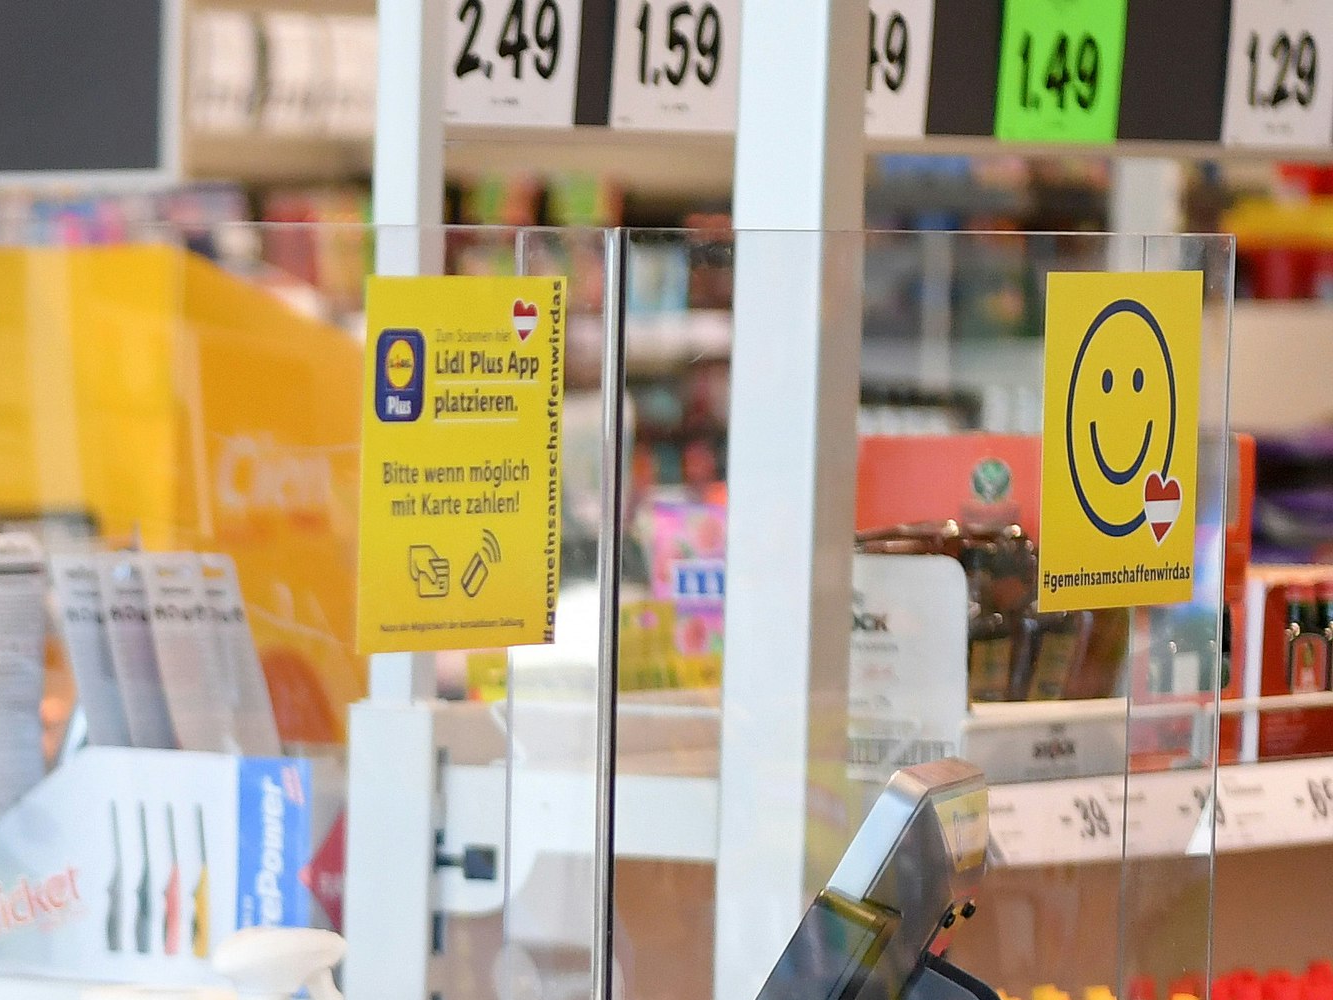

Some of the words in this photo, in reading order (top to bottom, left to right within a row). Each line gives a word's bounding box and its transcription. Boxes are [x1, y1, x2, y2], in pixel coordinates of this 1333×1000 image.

[454, 0, 562, 79] 2.49
[636, 1, 722, 86] 1.59
[1019, 31, 1101, 110] 1.49
[1247, 31, 1318, 108] 1.29
[436, 351, 465, 374] Lidl
[470, 350, 503, 374] Plus
[507, 350, 540, 380] App
[435, 387, 519, 418] platzieren.
[383, 462, 419, 485] Bitte
[425, 466, 465, 484] wenn
[469, 458, 530, 488] möglich
[391, 493, 416, 516] mit
[421, 492, 462, 516] Karte
[466, 490, 520, 515] zahlen!
[1043, 561, 1191, 593] #gemeinsamschaffenwirdas
